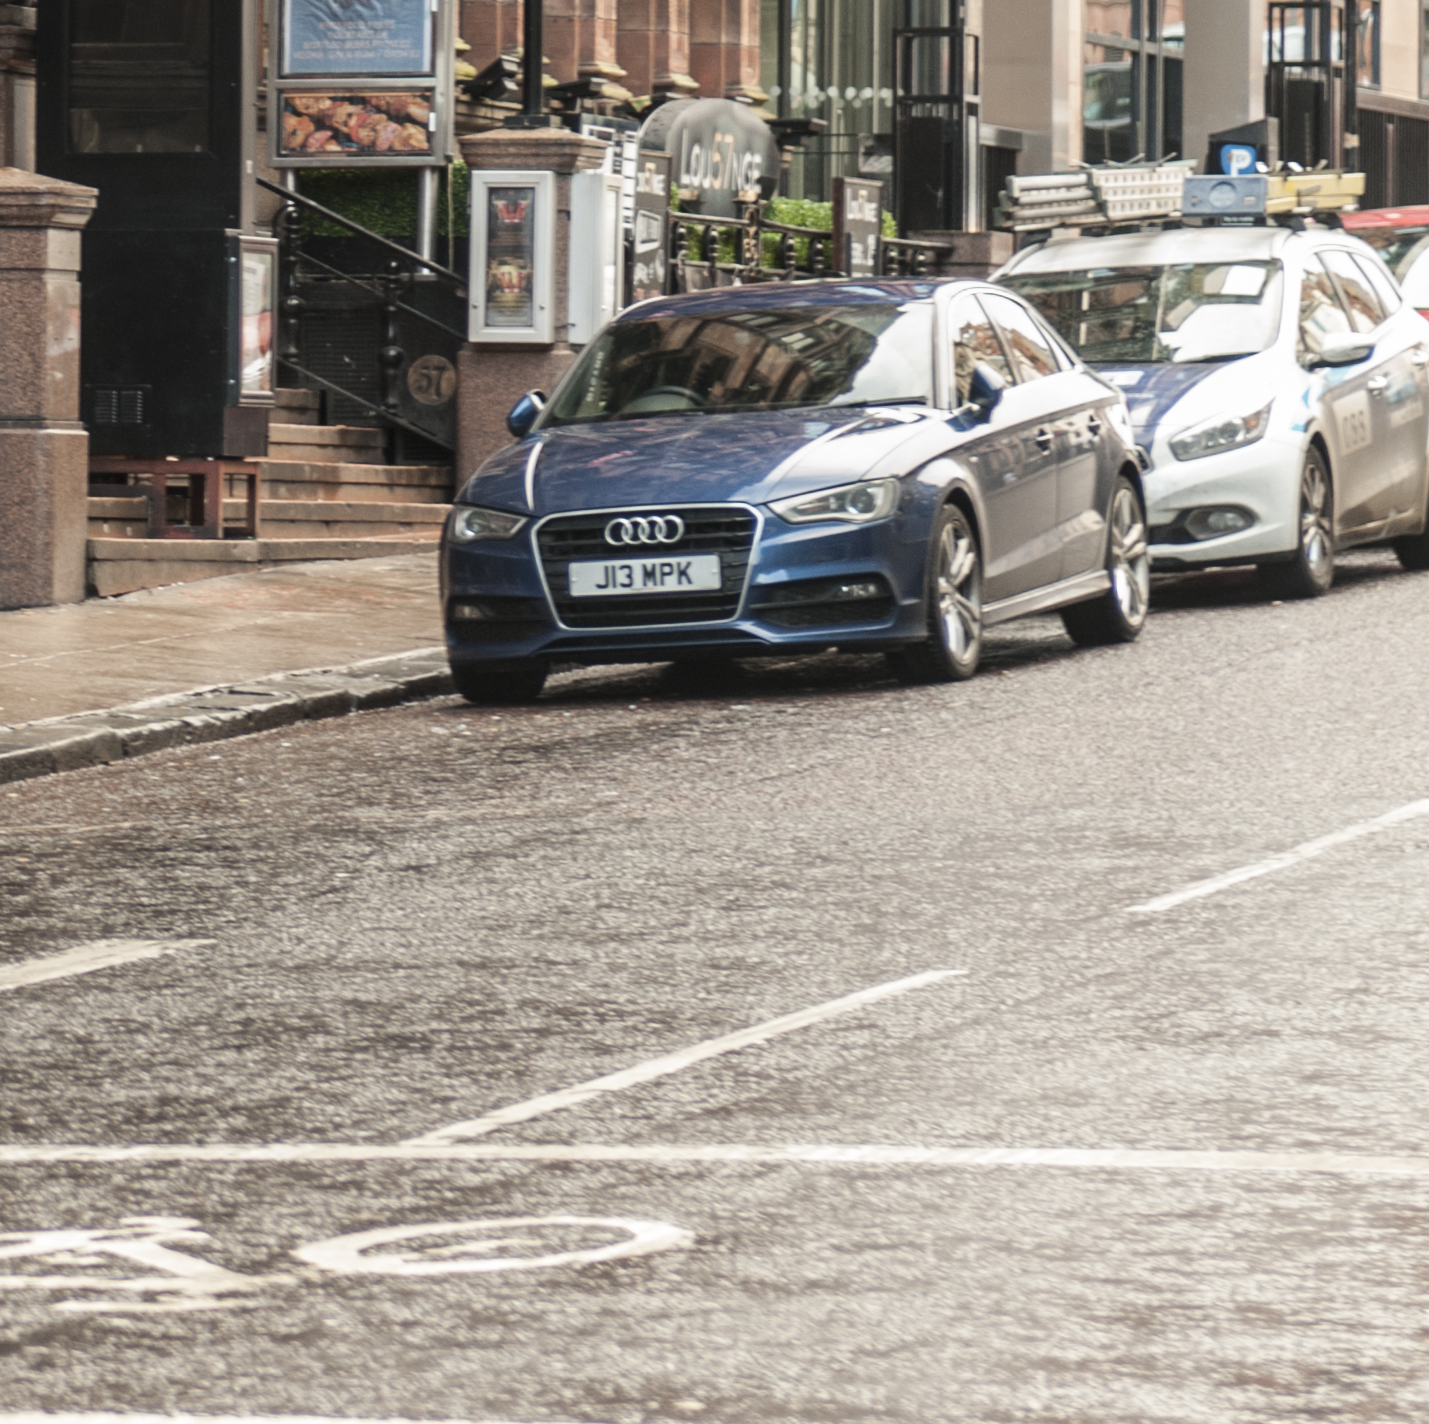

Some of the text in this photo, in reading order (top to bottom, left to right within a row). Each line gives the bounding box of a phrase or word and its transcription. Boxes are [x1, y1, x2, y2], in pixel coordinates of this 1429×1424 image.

[414, 365, 448, 400] 57
[595, 561, 693, 590] J13 MPK
